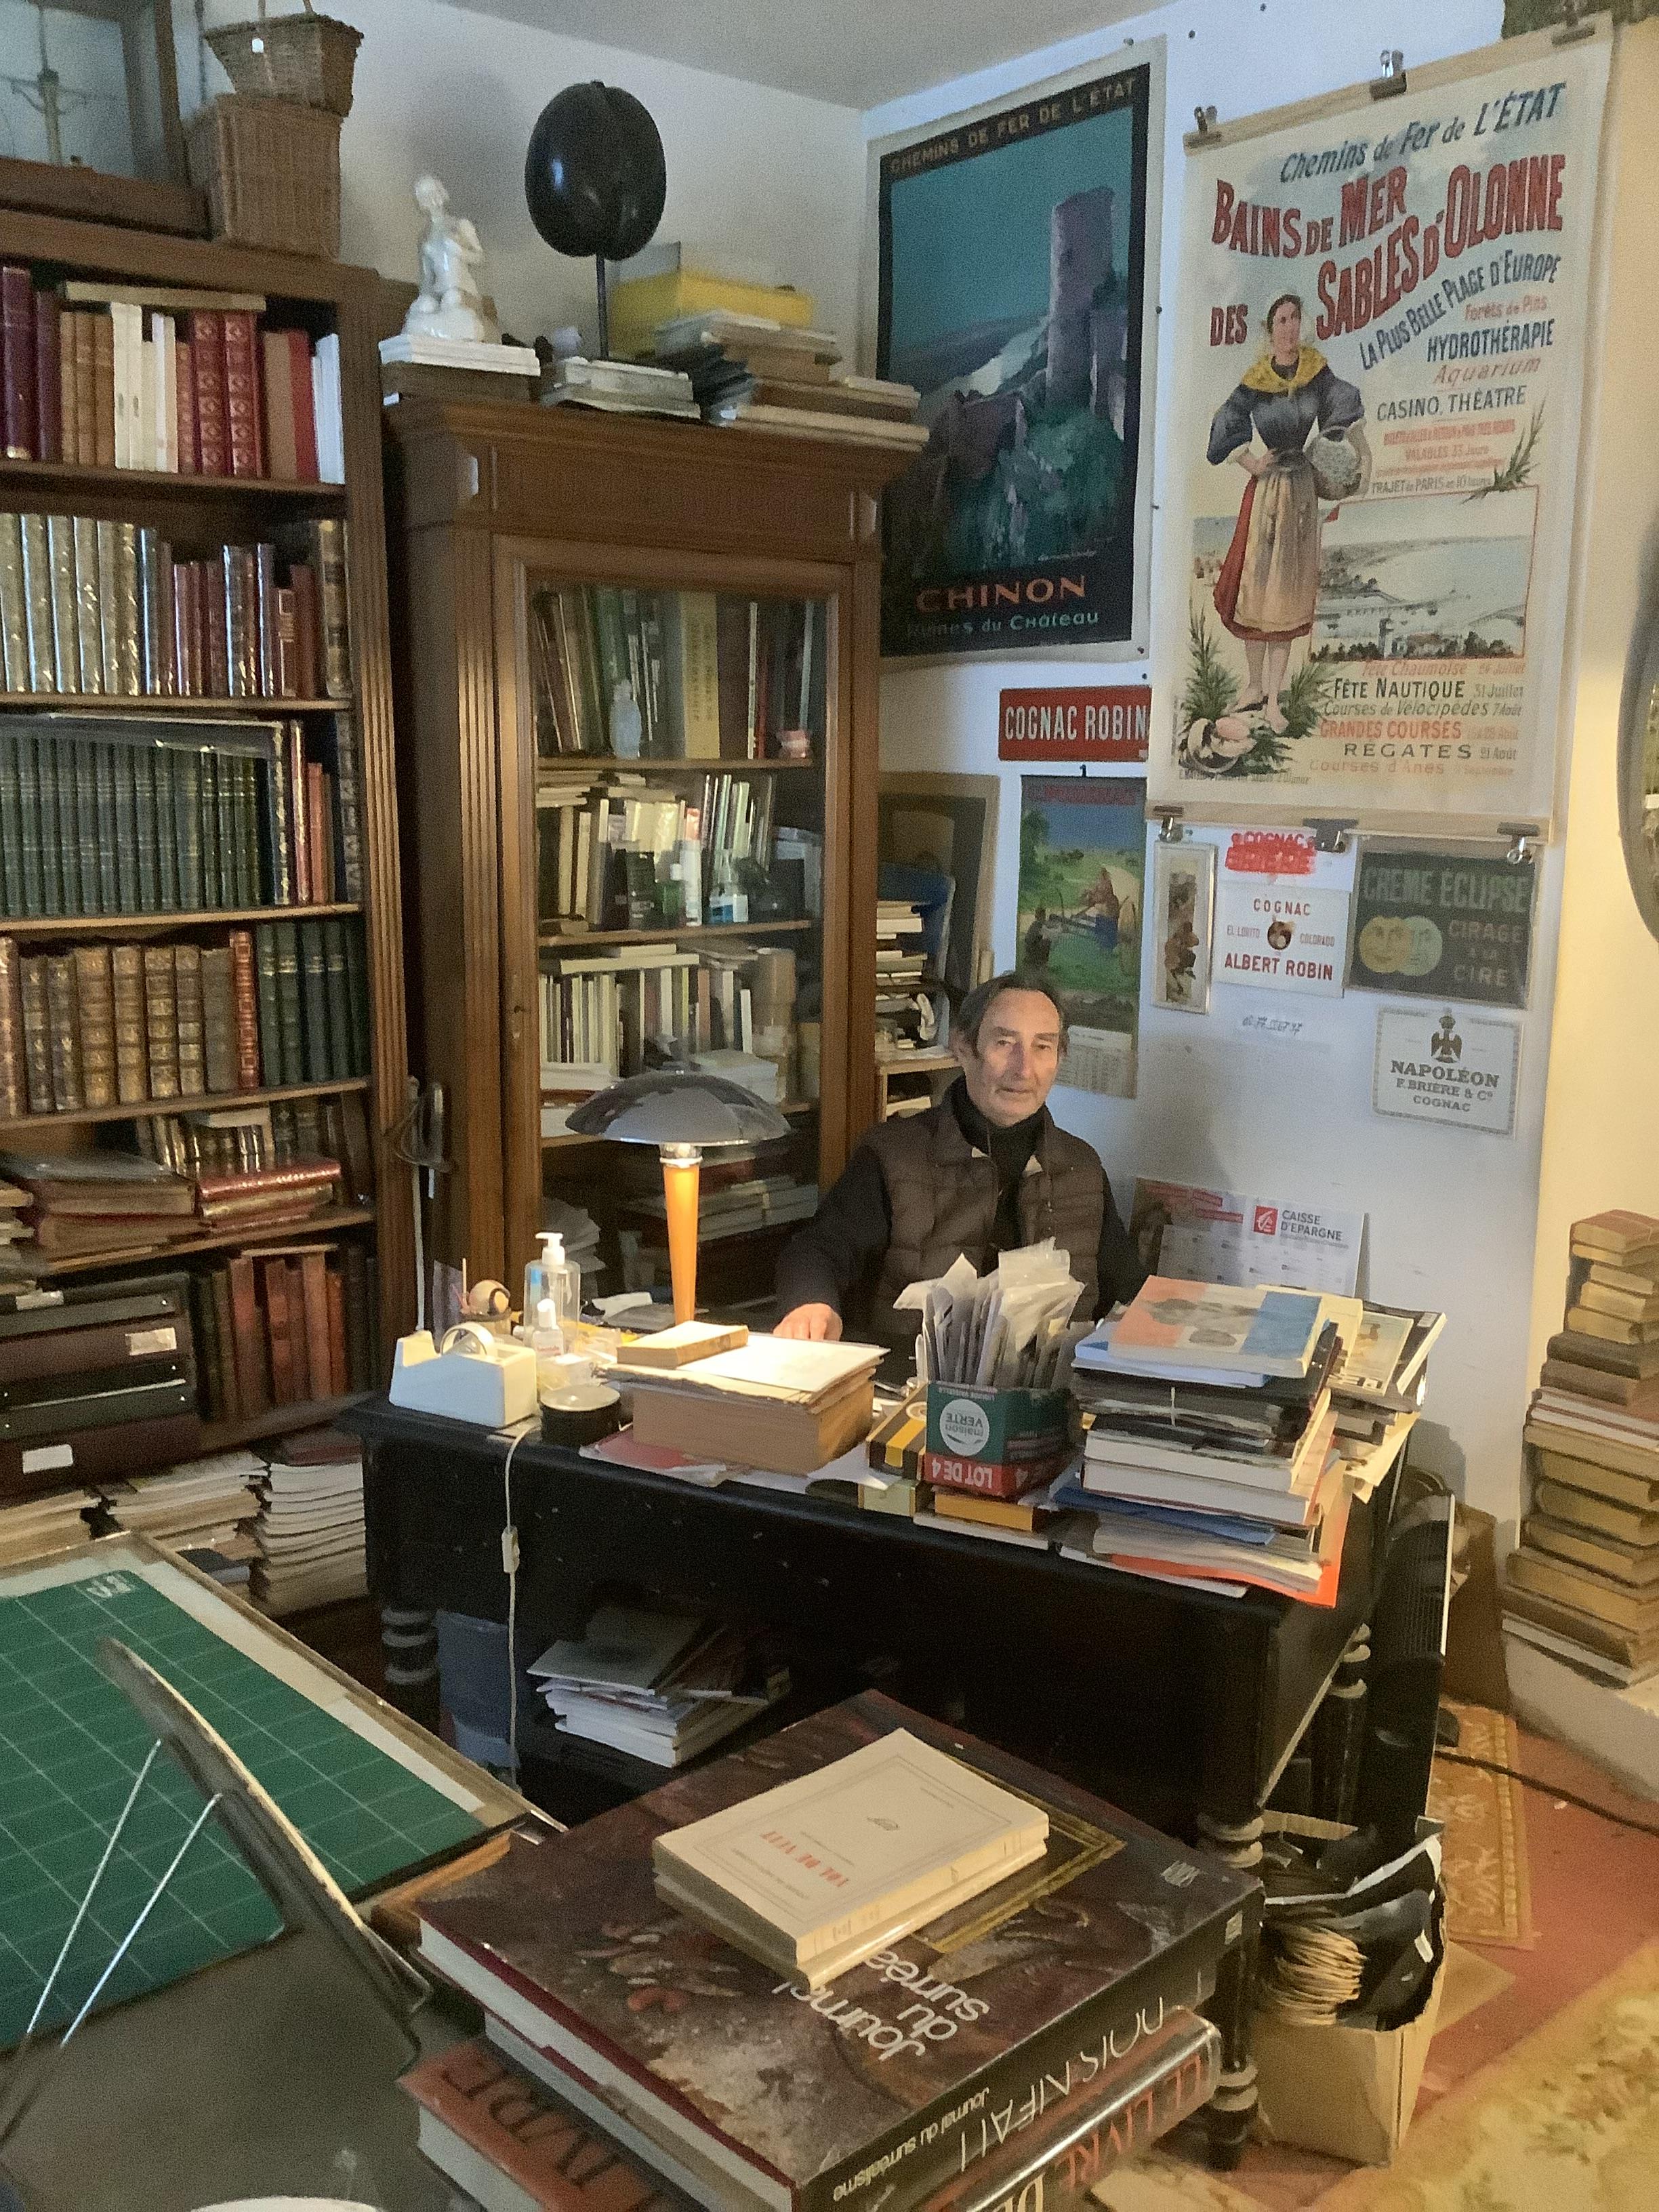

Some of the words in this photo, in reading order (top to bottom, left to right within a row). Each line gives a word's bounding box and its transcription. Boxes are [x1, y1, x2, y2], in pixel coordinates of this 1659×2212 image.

[968, 129, 989, 147] DE
[998, 113, 1029, 137] FER
[1039, 104, 1062, 125] DE
[1279, 143, 1366, 183] Chemins
[1373, 141, 1394, 160] de
[1399, 119, 1443, 157] Fer
[1442, 116, 1466, 144] de
[1474, 81, 1567, 136] L'ÉTAT
[1212, 179, 1303, 259] BAINS
[1305, 216, 1334, 256] DE
[1338, 165, 1408, 247] MER
[1210, 304, 1248, 346] DES
[1315, 215, 1420, 341] SABLES
[1359, 341, 1379, 371] LA
[1376, 320, 1411, 360] PLUS
[1406, 292, 1448, 337] BELLE
[1441, 266, 1486, 309] PLAGE
[1490, 248, 1561, 288] D'EUROPE
[1427, 318, 1555, 362] HYDROTHÉRAPIE
[1433, 356, 1542, 387] Aquarium
[916, 575, 1086, 612] CHINON
[981, 617, 1002, 633] du
[1334, 677, 1368, 699] FÊTE
[1376, 677, 1465, 701] NAUTIQUE
[1323, 700, 1381, 717] Courses
[1006, 704, 1078, 741] COGNAC
[1084, 704, 1147, 741] ROBIN
[1320, 719, 1382, 739] GRANDES
[1387, 719, 1462, 739] COURSES
[1309, 760, 1380, 773] Courses
[1253, 898, 1311, 916] COGNAC
[1224, 952, 1280, 975] ALBERT
[1285, 959, 1334, 981] ROBIN
[1413, 1094, 1471, 1112] COGNAC
[1282, 1210, 1322, 1226] CAISSE
[945, 1412, 983, 1428] VERTE
[931, 1458, 941, 1479] 4
[943, 1460, 963, 1482] DE
[964, 1465, 993, 1489] LOT
[897, 2003, 958, 2041] du
[941, 2087, 989, 2134] Journal
[920, 2122, 939, 2145] du
[833, 2136, 916, 2202] surréalisme
